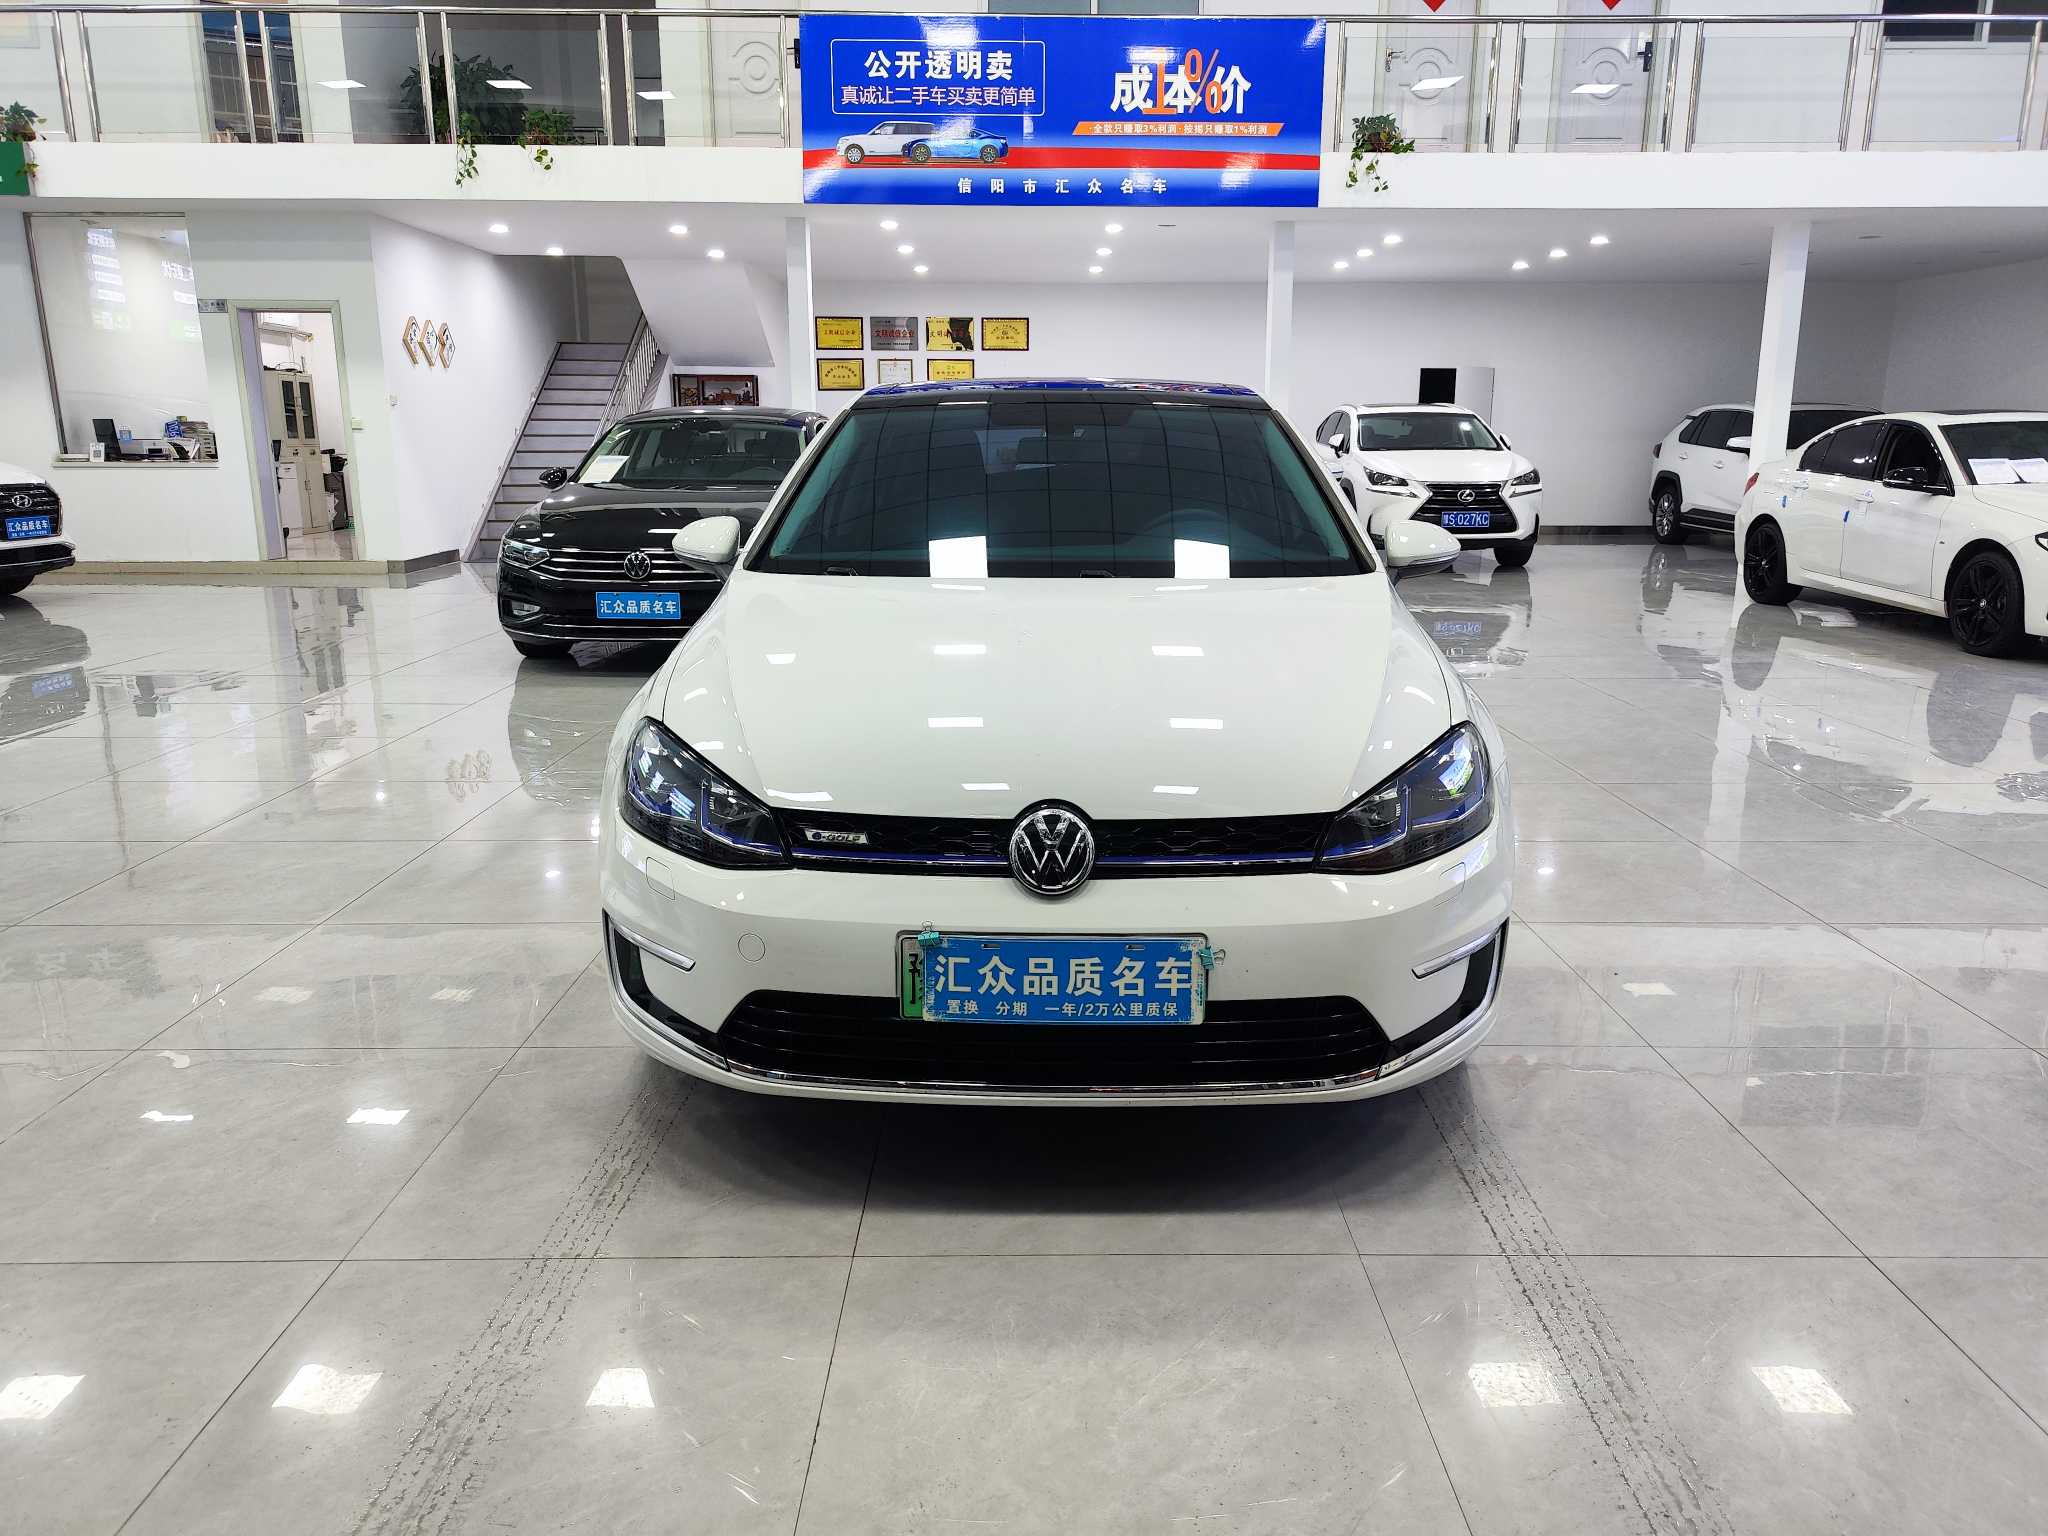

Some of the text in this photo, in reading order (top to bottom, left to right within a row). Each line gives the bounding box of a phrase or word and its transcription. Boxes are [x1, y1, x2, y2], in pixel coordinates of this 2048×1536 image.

[864, 50, 1013, 81] 公开透明卖
[841, 86, 1036, 106] 真诚让二手车买卖更简单
[600, 599, 678, 614] 汇众品质名车
[934, 954, 1192, 997] 汇众品质名车
[947, 999, 1178, 1018] 置换 分期 一年/2万公里质保
